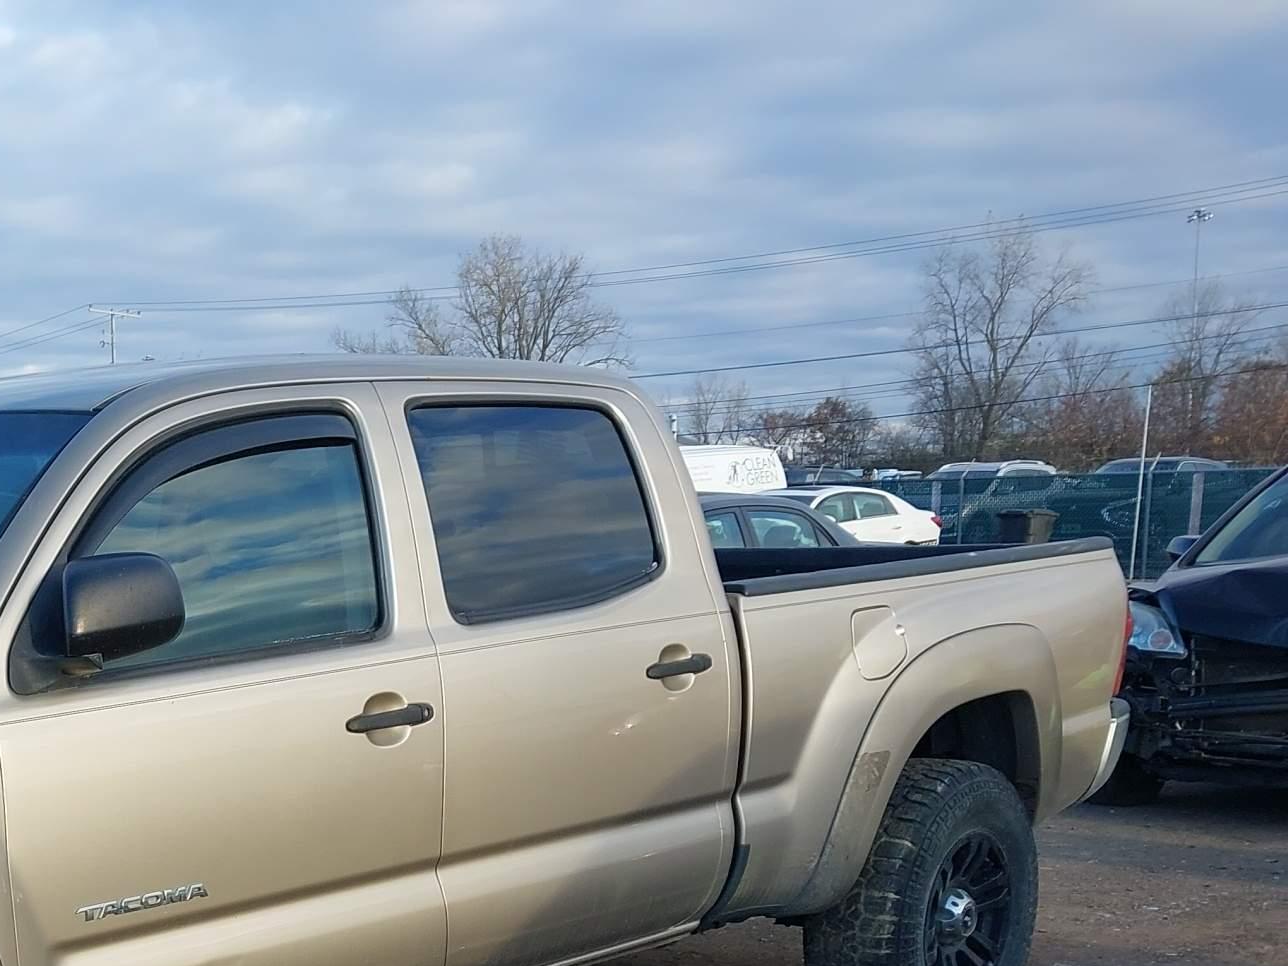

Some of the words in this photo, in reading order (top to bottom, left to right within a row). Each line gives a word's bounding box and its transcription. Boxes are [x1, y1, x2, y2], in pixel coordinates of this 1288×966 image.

[743, 456, 777, 471] CLEAN
[746, 471, 779, 486] GREEN
[75, 883, 209, 921] TACOMA
